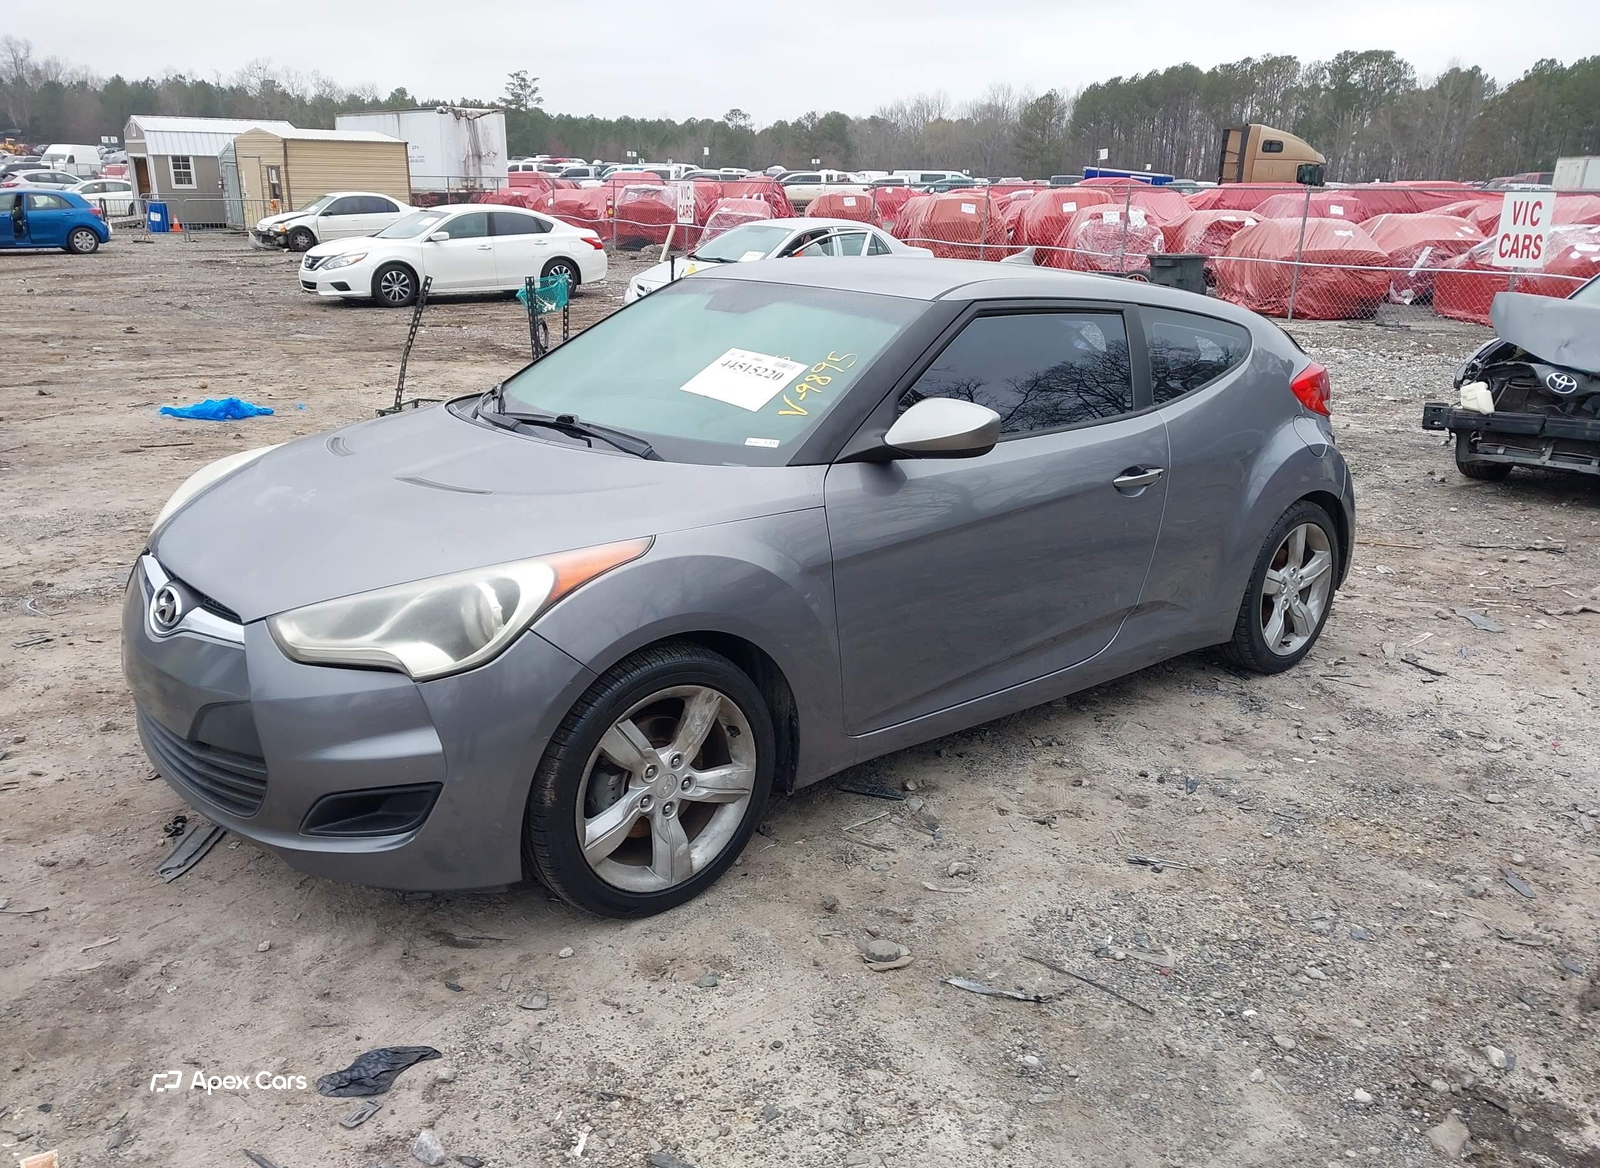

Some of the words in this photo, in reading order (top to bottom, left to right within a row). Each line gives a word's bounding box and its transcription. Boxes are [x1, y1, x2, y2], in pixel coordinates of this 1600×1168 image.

[679, 204, 692, 219] CARS
[1512, 200, 1543, 227] VIC
[1498, 233, 1544, 260] CARS
[720, 359, 785, 381] 44515220
